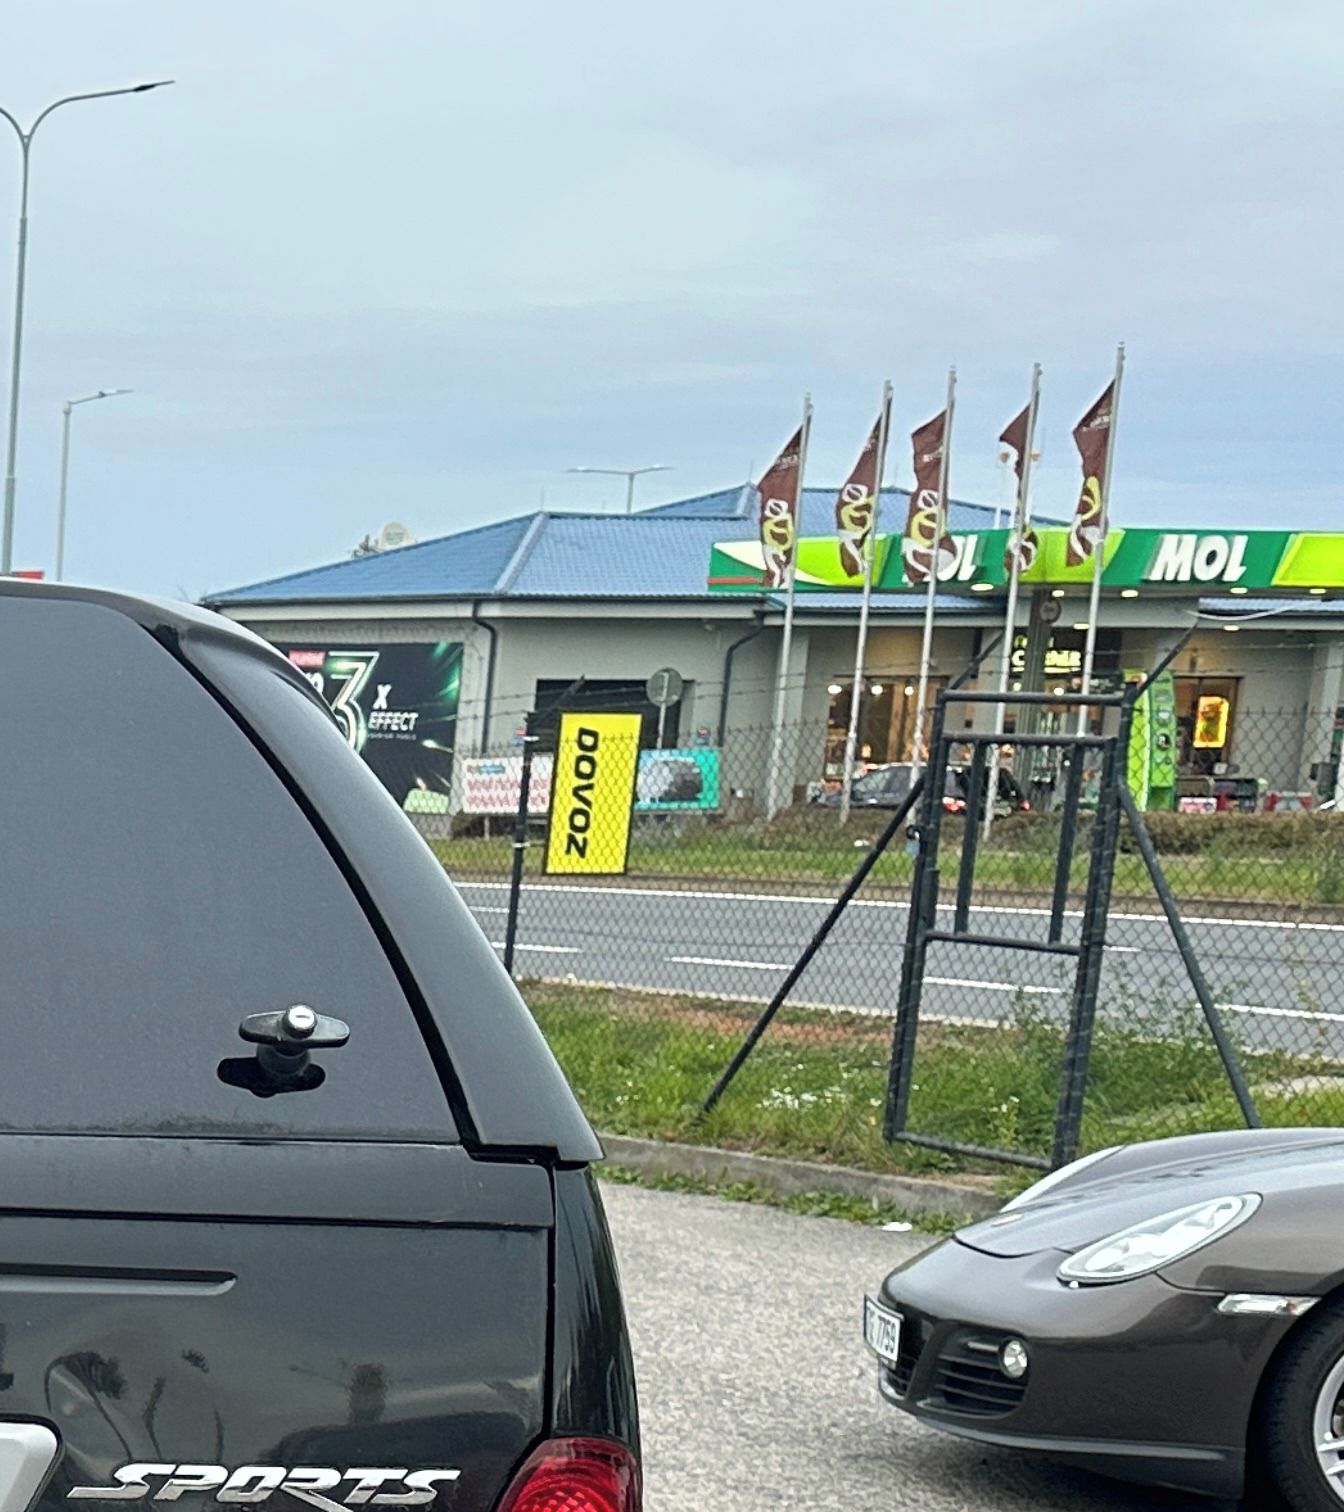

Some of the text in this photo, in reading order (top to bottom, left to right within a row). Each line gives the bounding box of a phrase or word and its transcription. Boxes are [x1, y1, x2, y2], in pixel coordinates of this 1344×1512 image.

[1149, 534, 1249, 582] MOL
[368, 711, 419, 731] EFFECT
[565, 727, 599, 859] DOVOZ
